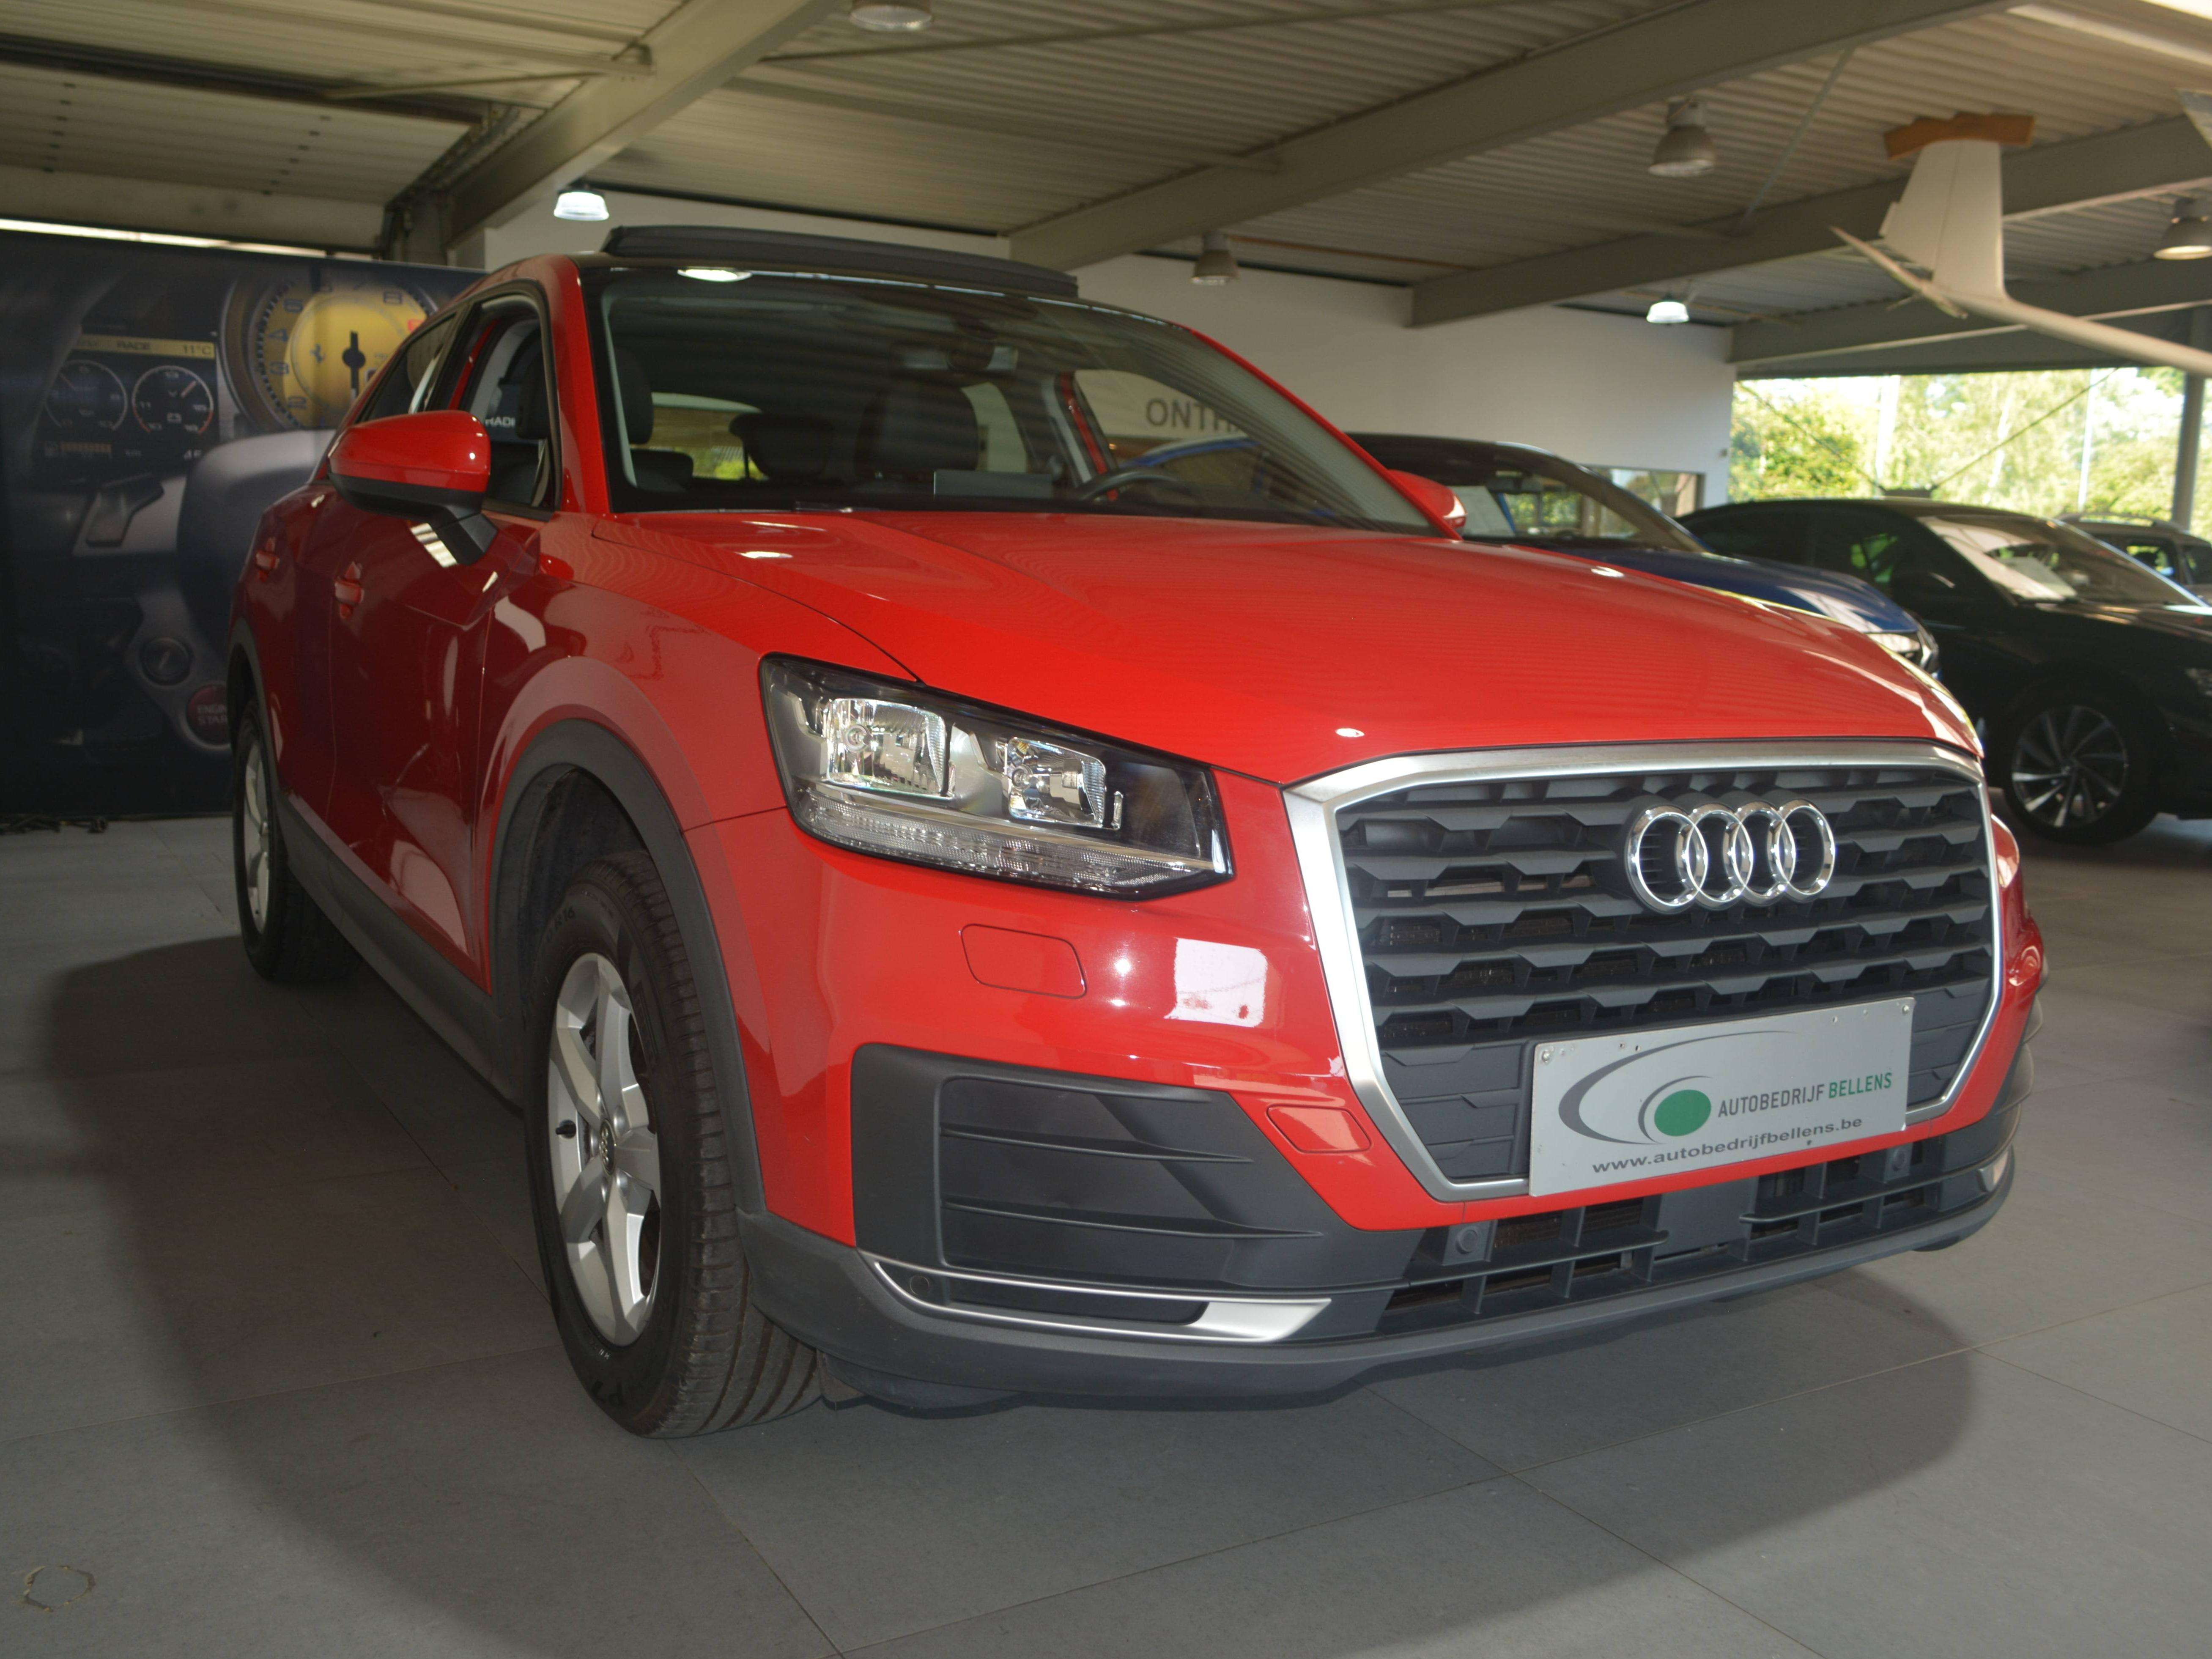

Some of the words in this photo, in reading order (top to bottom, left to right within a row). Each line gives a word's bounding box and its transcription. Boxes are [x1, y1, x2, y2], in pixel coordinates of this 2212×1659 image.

[1718, 1084, 1825, 1118] AUTOBEDRIJF
[1828, 1072, 1892, 1099] BELLENS
[1593, 1117, 1862, 1173] www.autobedrijfbellens.be
